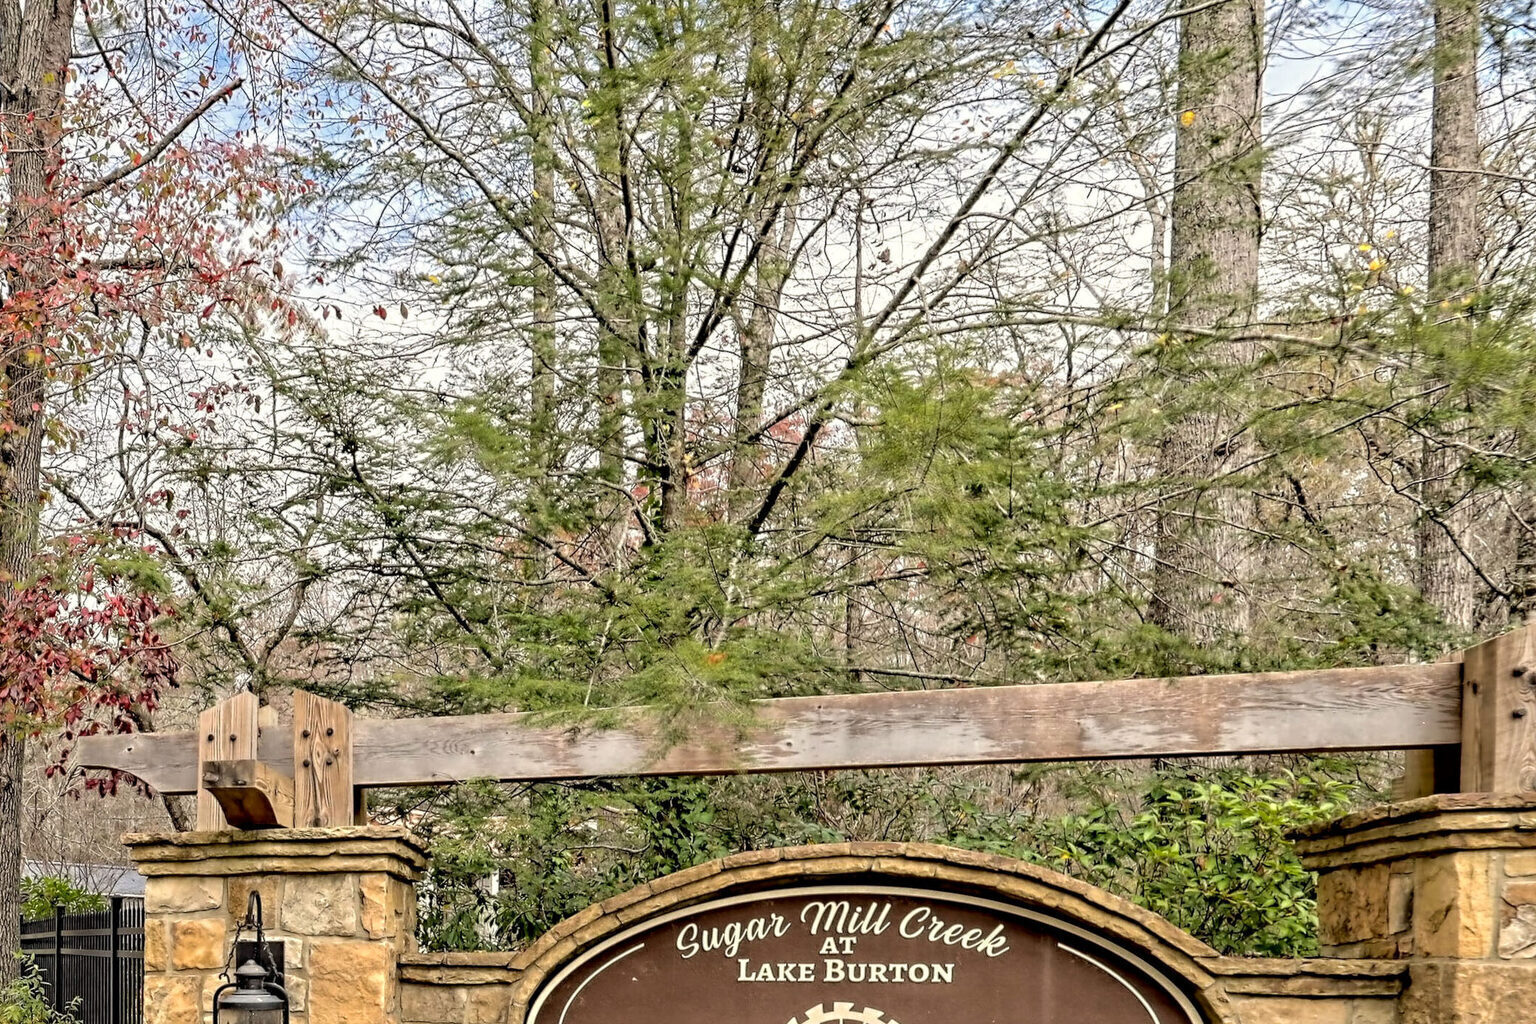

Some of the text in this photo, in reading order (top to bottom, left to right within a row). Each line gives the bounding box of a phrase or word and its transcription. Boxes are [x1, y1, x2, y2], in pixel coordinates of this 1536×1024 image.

[676, 900, 1011, 959] Sugar Mill Creek
[819, 935, 858, 955] AT
[737, 958, 955, 983] LAKE BURTON
